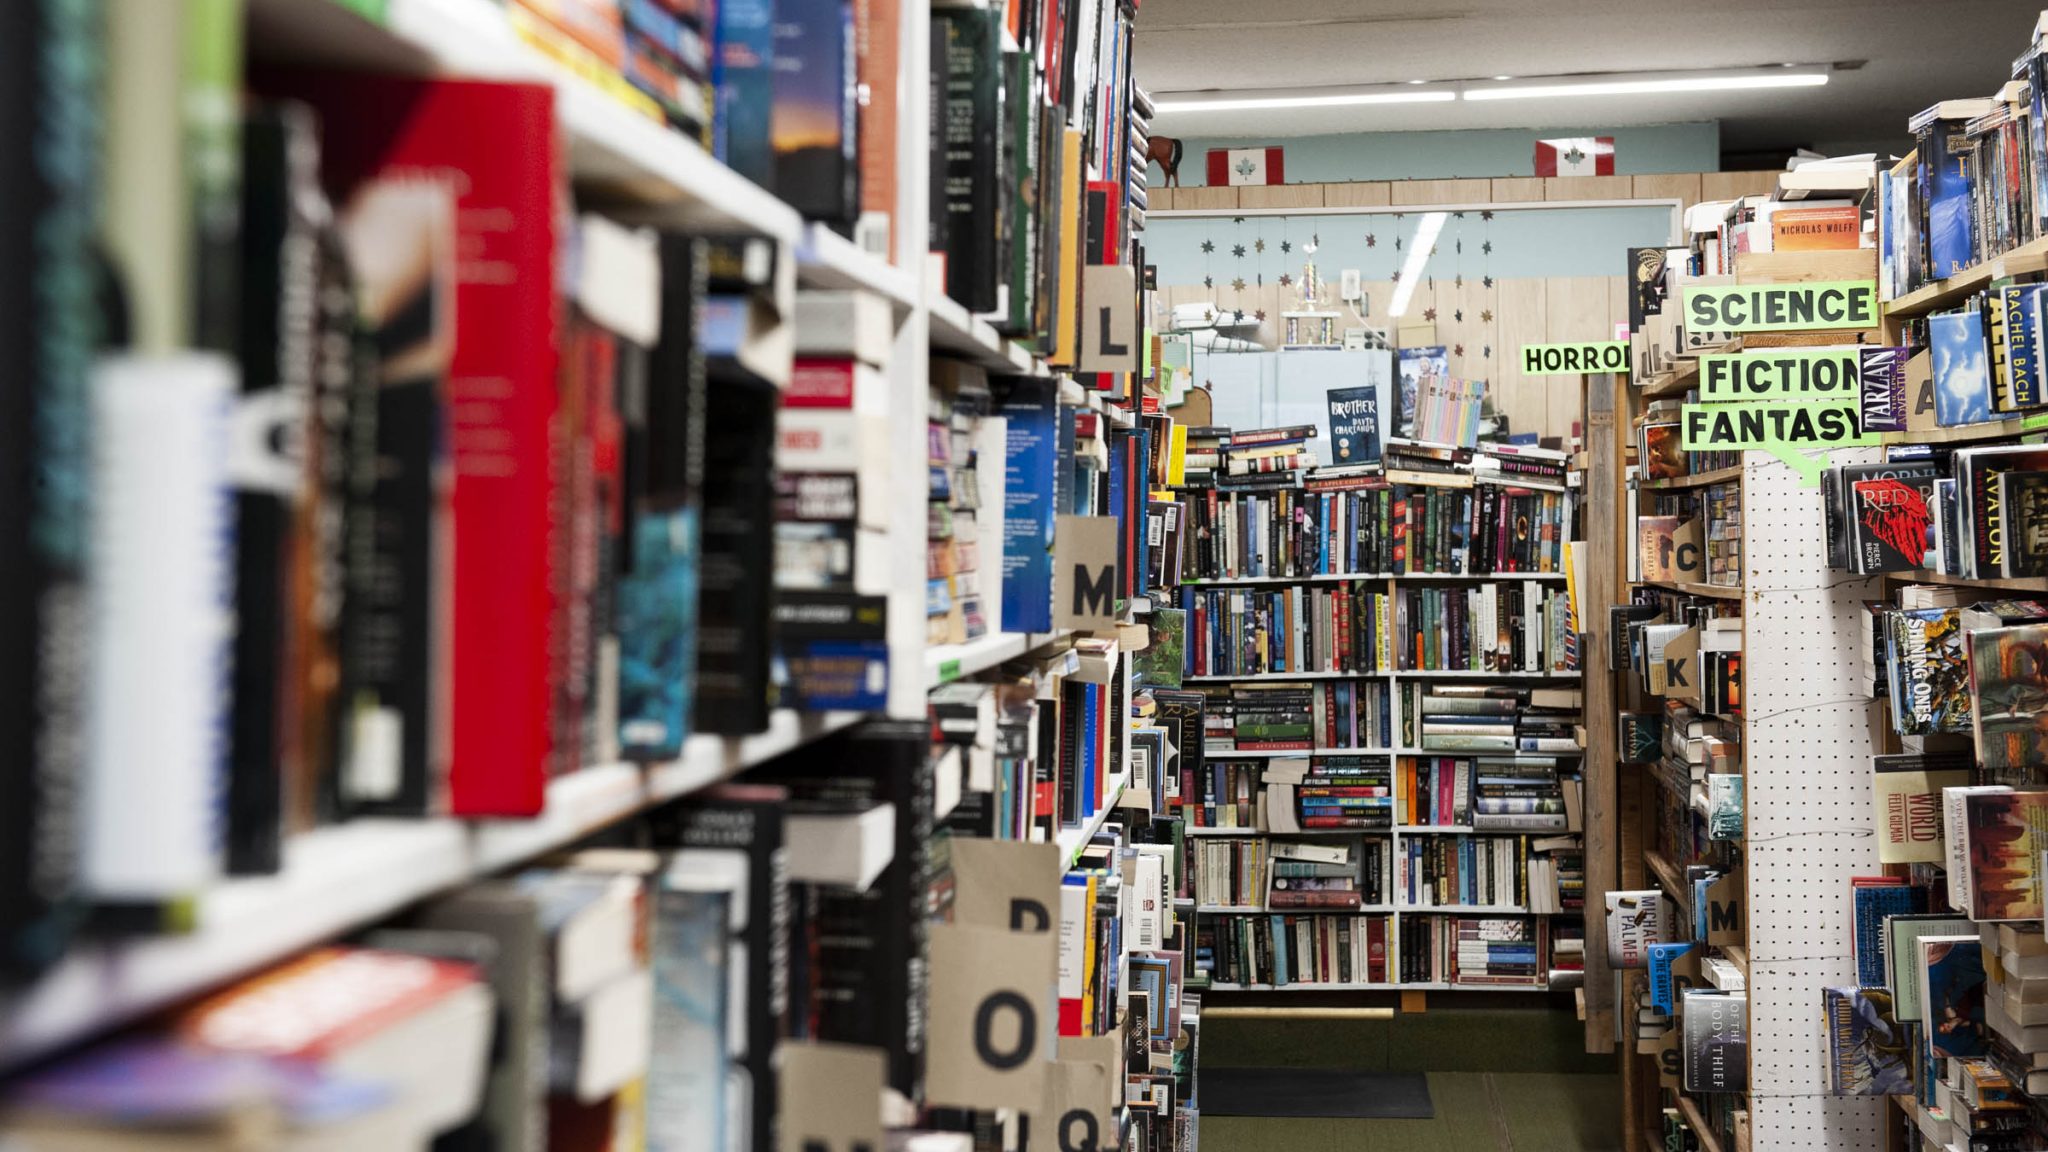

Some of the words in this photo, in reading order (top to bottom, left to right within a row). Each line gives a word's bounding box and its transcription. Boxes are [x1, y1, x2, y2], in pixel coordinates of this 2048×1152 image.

[1780, 224, 1822, 235] NICHOLAS
[1826, 223, 1854, 233] WOLFF
[1691, 287, 1870, 326] SCIENCE
[2007, 289, 2024, 352] RACHEL
[1100, 307, 1128, 355] L
[1526, 345, 1630, 372] HORRO
[1707, 358, 1860, 394] FICTION
[1863, 350, 1897, 428] TARZAN
[1896, 350, 1907, 424] ADVENTURES
[2013, 358, 2030, 403] BACH
[1331, 399, 1376, 418] BROTHER
[1688, 409, 1863, 444] FANTASY
[1863, 488, 1909, 513] RED
[1986, 468, 2001, 565] AVALON
[1676, 543, 1698, 571] C
[1865, 542, 1875, 569] BROWN
[1073, 563, 1115, 616] M
[1907, 619, 1928, 679] SHINING
[1666, 658, 1689, 687] K
[1912, 683, 1932, 723] ONES
[1183, 705, 1198, 762] AURIEL
[1888, 793, 1902, 813] FELIX
[1908, 792, 1936, 842] WORLD
[1889, 815, 1904, 843] GILMAN
[1957, 821, 1965, 834] THE
[1711, 901, 1738, 931] M
[1622, 915, 1638, 967] PALMER
[1656, 959, 1665, 973] THE
[1657, 975, 1668, 1004] GRAVES
[974, 989, 1038, 1072] O
[1711, 1002, 1723, 1041] BODY
[1730, 1003, 1739, 1022] OF
[1731, 1024, 1740, 1044] THE
[1713, 1046, 1724, 1088] THIEF
[1058, 1109, 1099, 1152] Q
